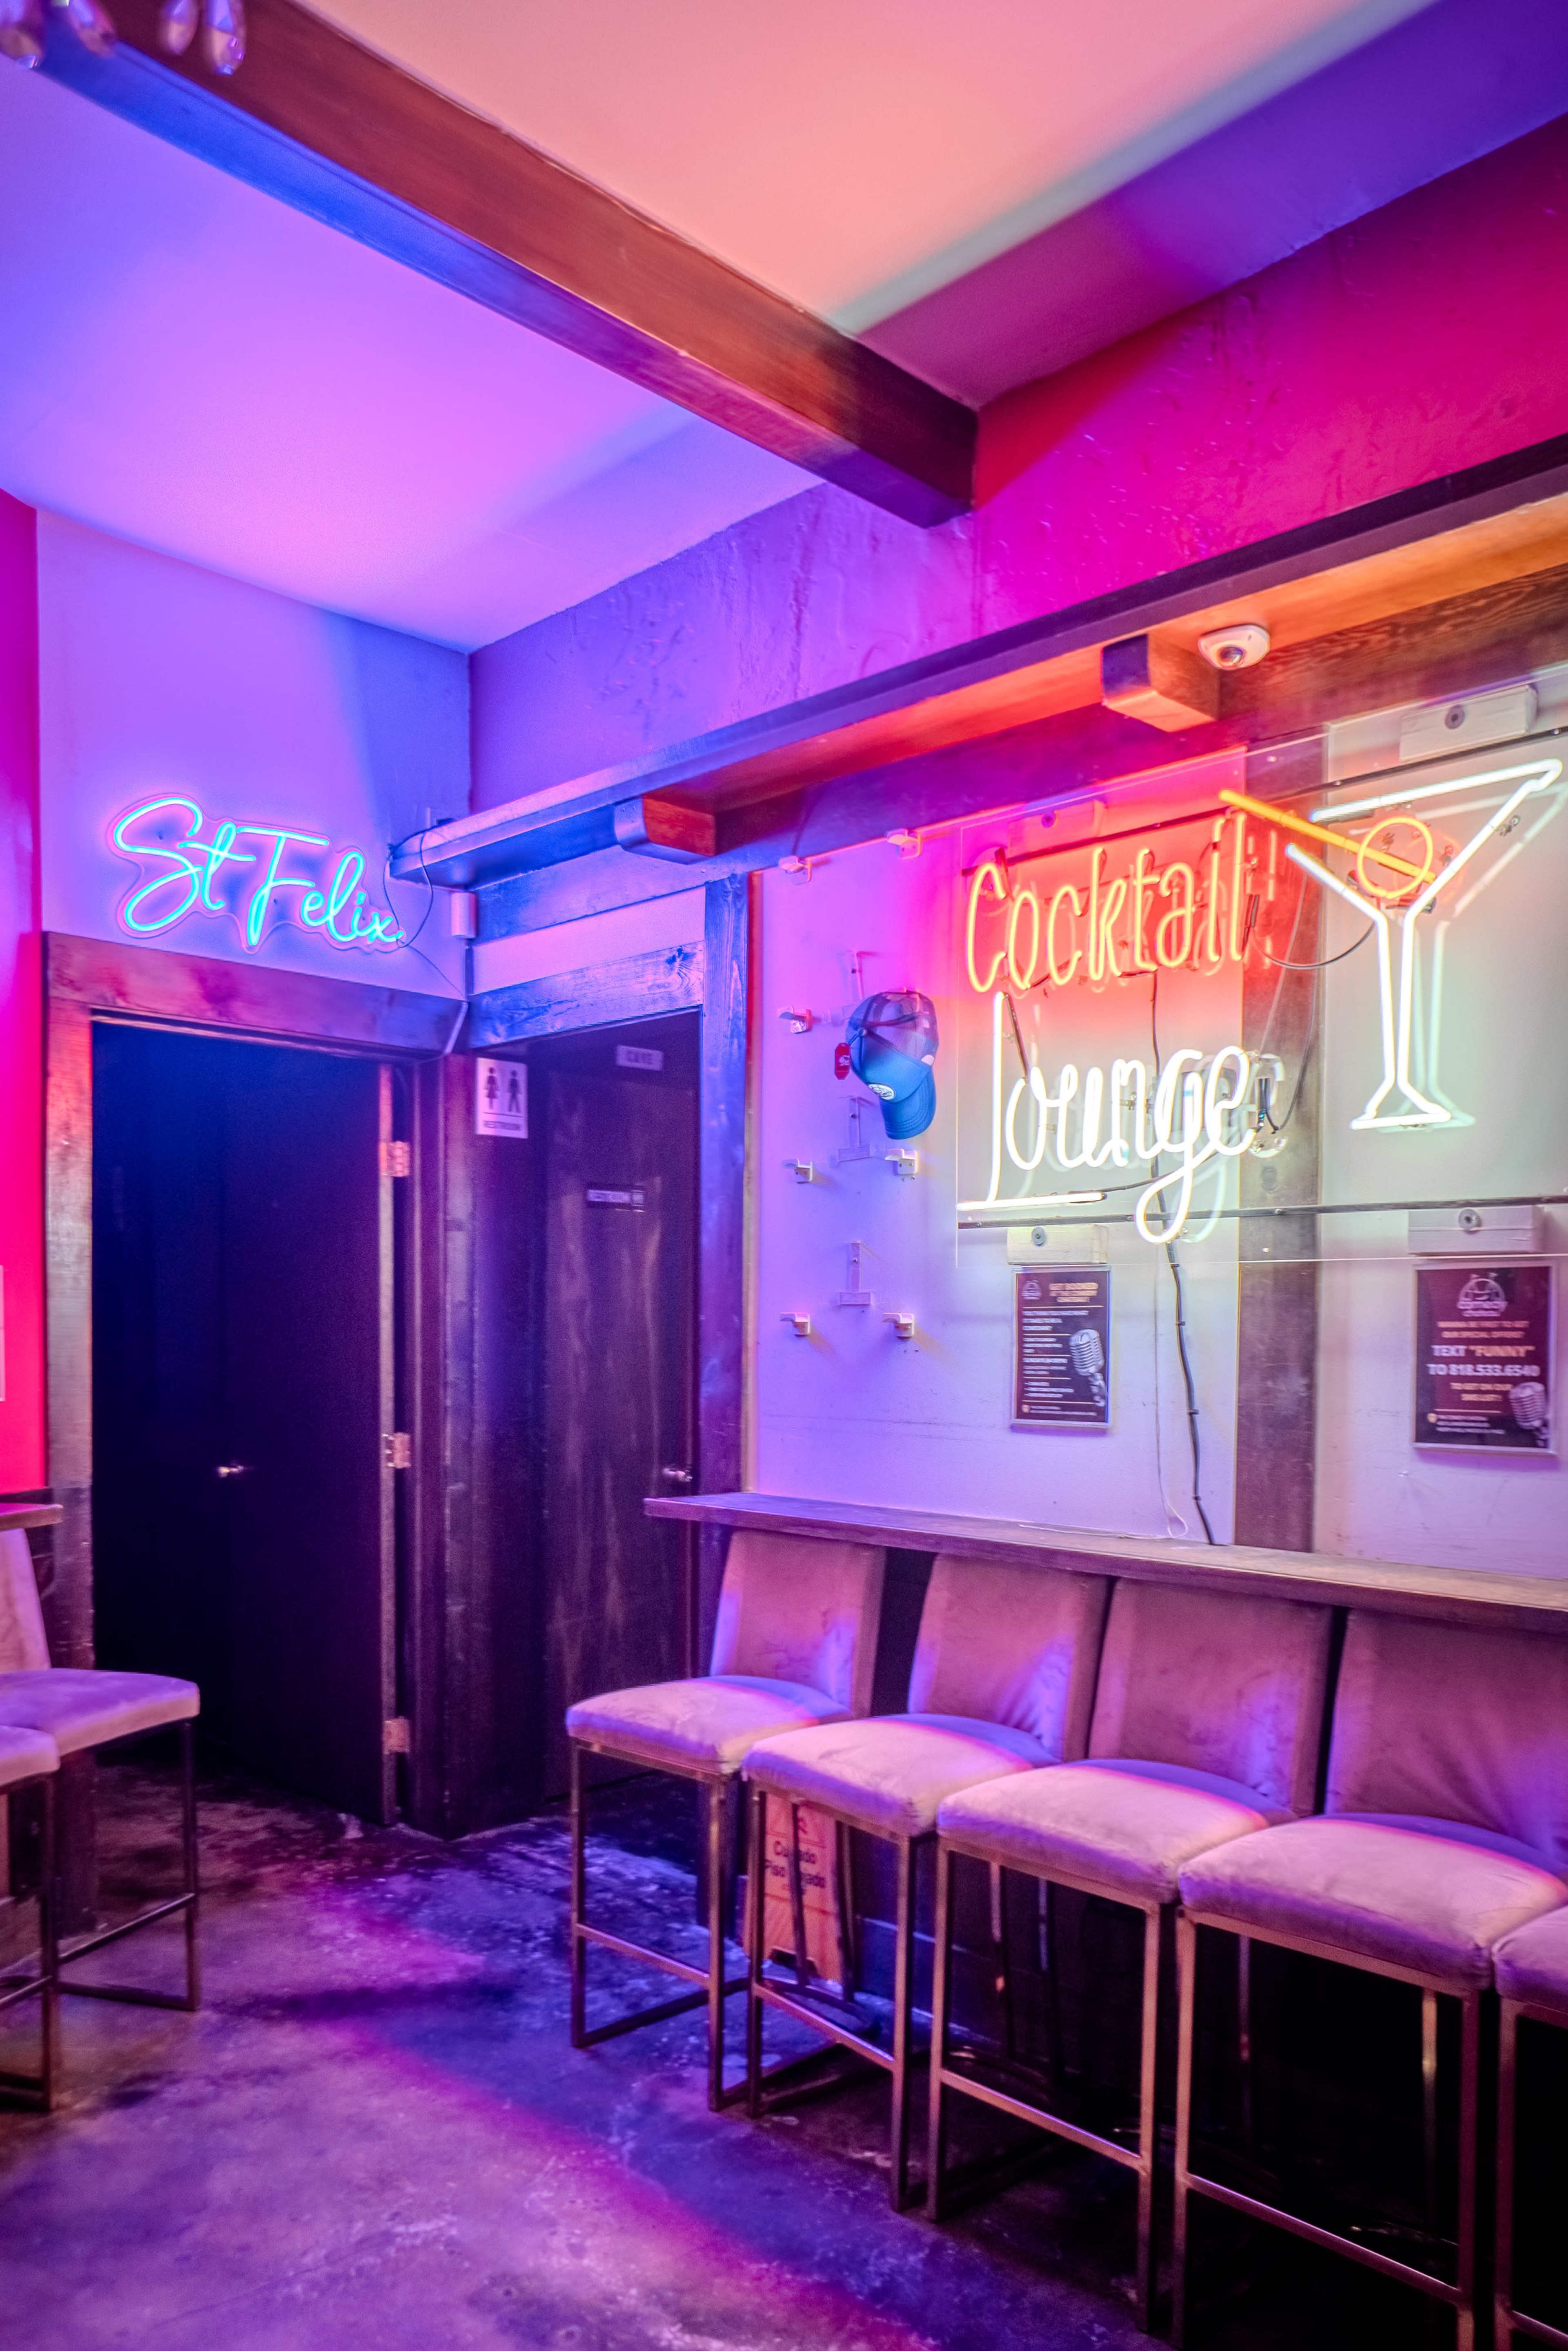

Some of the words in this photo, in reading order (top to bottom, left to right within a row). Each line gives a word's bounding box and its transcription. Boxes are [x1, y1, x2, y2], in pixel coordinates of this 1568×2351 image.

[114, 798, 256, 931] St
[236, 826, 403, 946] Felix
[967, 812, 1245, 993] Cocktail
[1426, 1364, 1448, 1375] TO
[1431, 1345, 1465, 1357] TEXT
